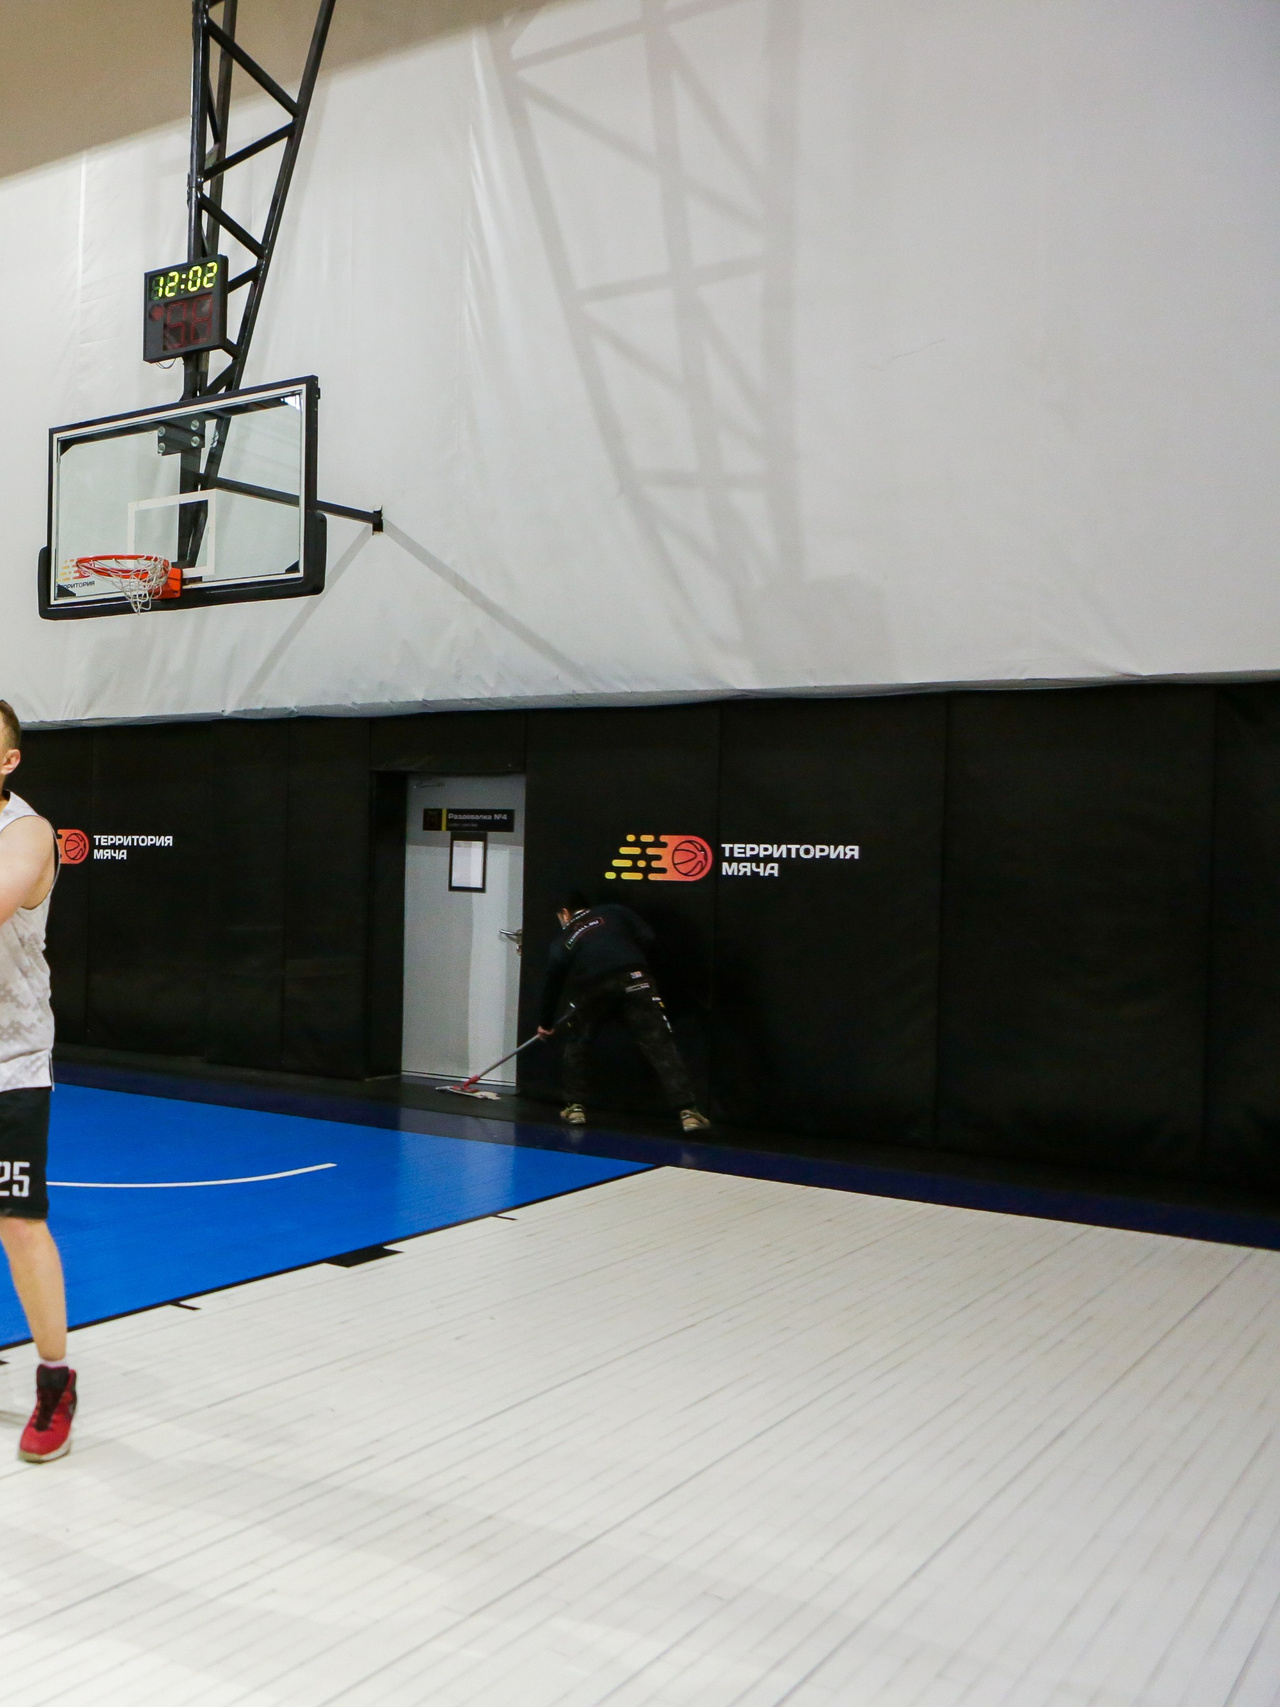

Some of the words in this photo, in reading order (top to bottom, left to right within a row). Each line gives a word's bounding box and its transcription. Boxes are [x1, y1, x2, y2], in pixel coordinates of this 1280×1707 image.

[158, 262, 218, 298] 12:02
[93, 835, 173, 847] ТЕРРИТОРИЯ
[93, 849, 127, 860] МЯЧА
[721, 843, 860, 860] ТЕРРИТОРИЯ
[721, 861, 779, 877] МЯЧА
